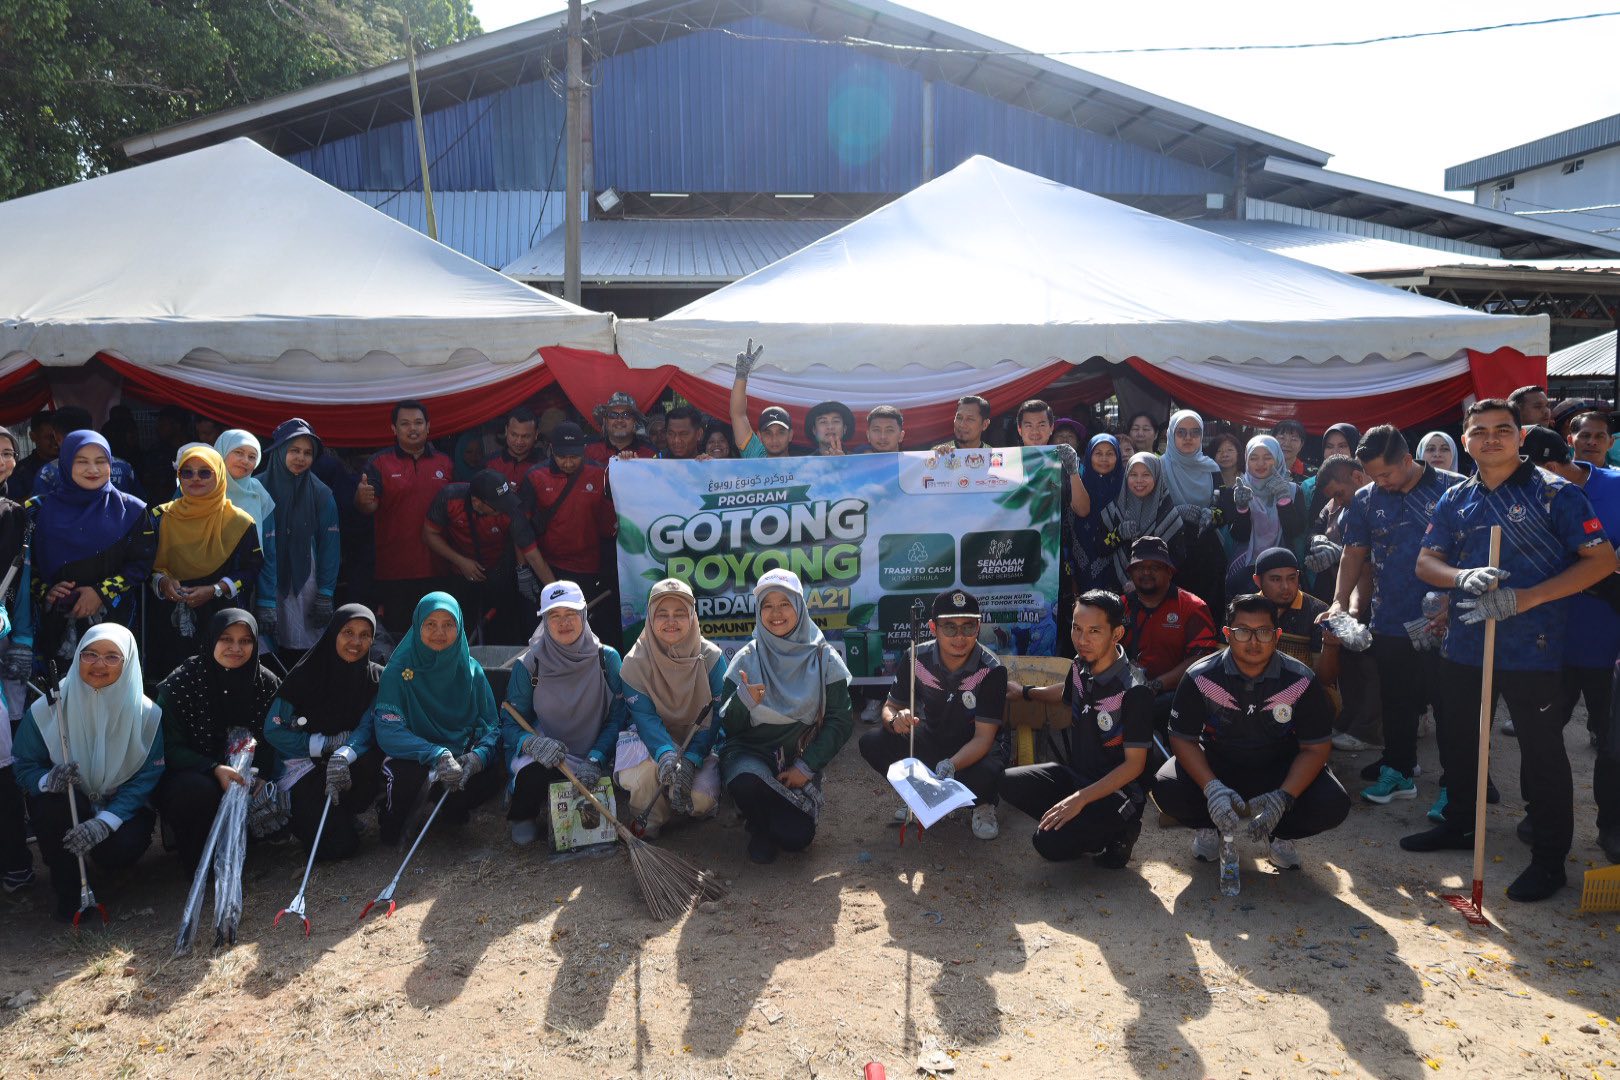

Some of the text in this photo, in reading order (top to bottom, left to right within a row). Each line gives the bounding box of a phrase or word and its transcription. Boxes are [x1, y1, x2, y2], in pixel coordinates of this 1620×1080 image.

[718, 490, 788, 506] PROGRAM
[649, 499, 867, 554] GOTONG
[667, 544, 860, 589] ROYONG
[977, 558, 1025, 567] SENAMAN
[980, 565, 1024, 574] AEROBIK
[927, 566, 952, 574] CASH
[700, 594, 757, 616] RDA
[1017, 611, 1040, 623] JAGA
[700, 621, 757, 635] OMUNIT
